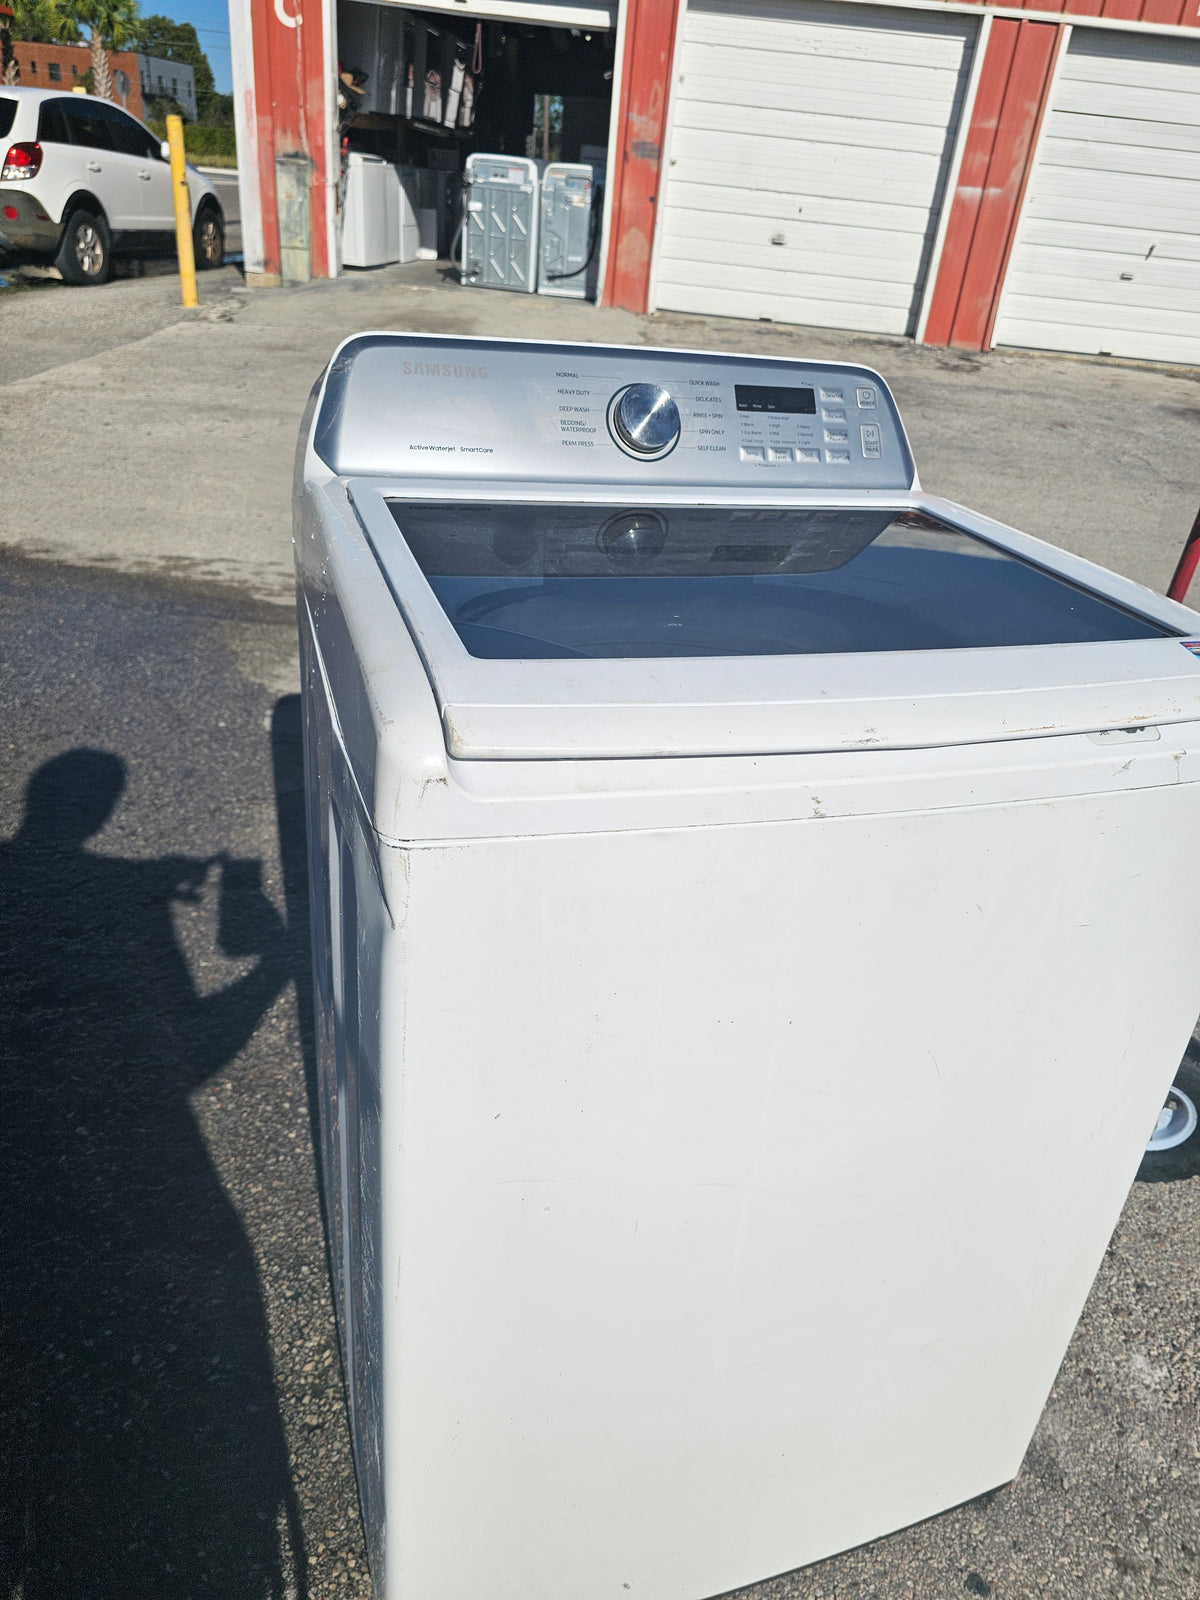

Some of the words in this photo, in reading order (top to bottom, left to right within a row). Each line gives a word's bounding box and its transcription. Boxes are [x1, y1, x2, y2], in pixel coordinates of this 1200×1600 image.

[402, 361, 489, 380] SAMSUNG
[555, 371, 580, 379] NORMAL
[560, 426, 597, 434] WATERPROOF
[577, 440, 595, 448] PRESS
